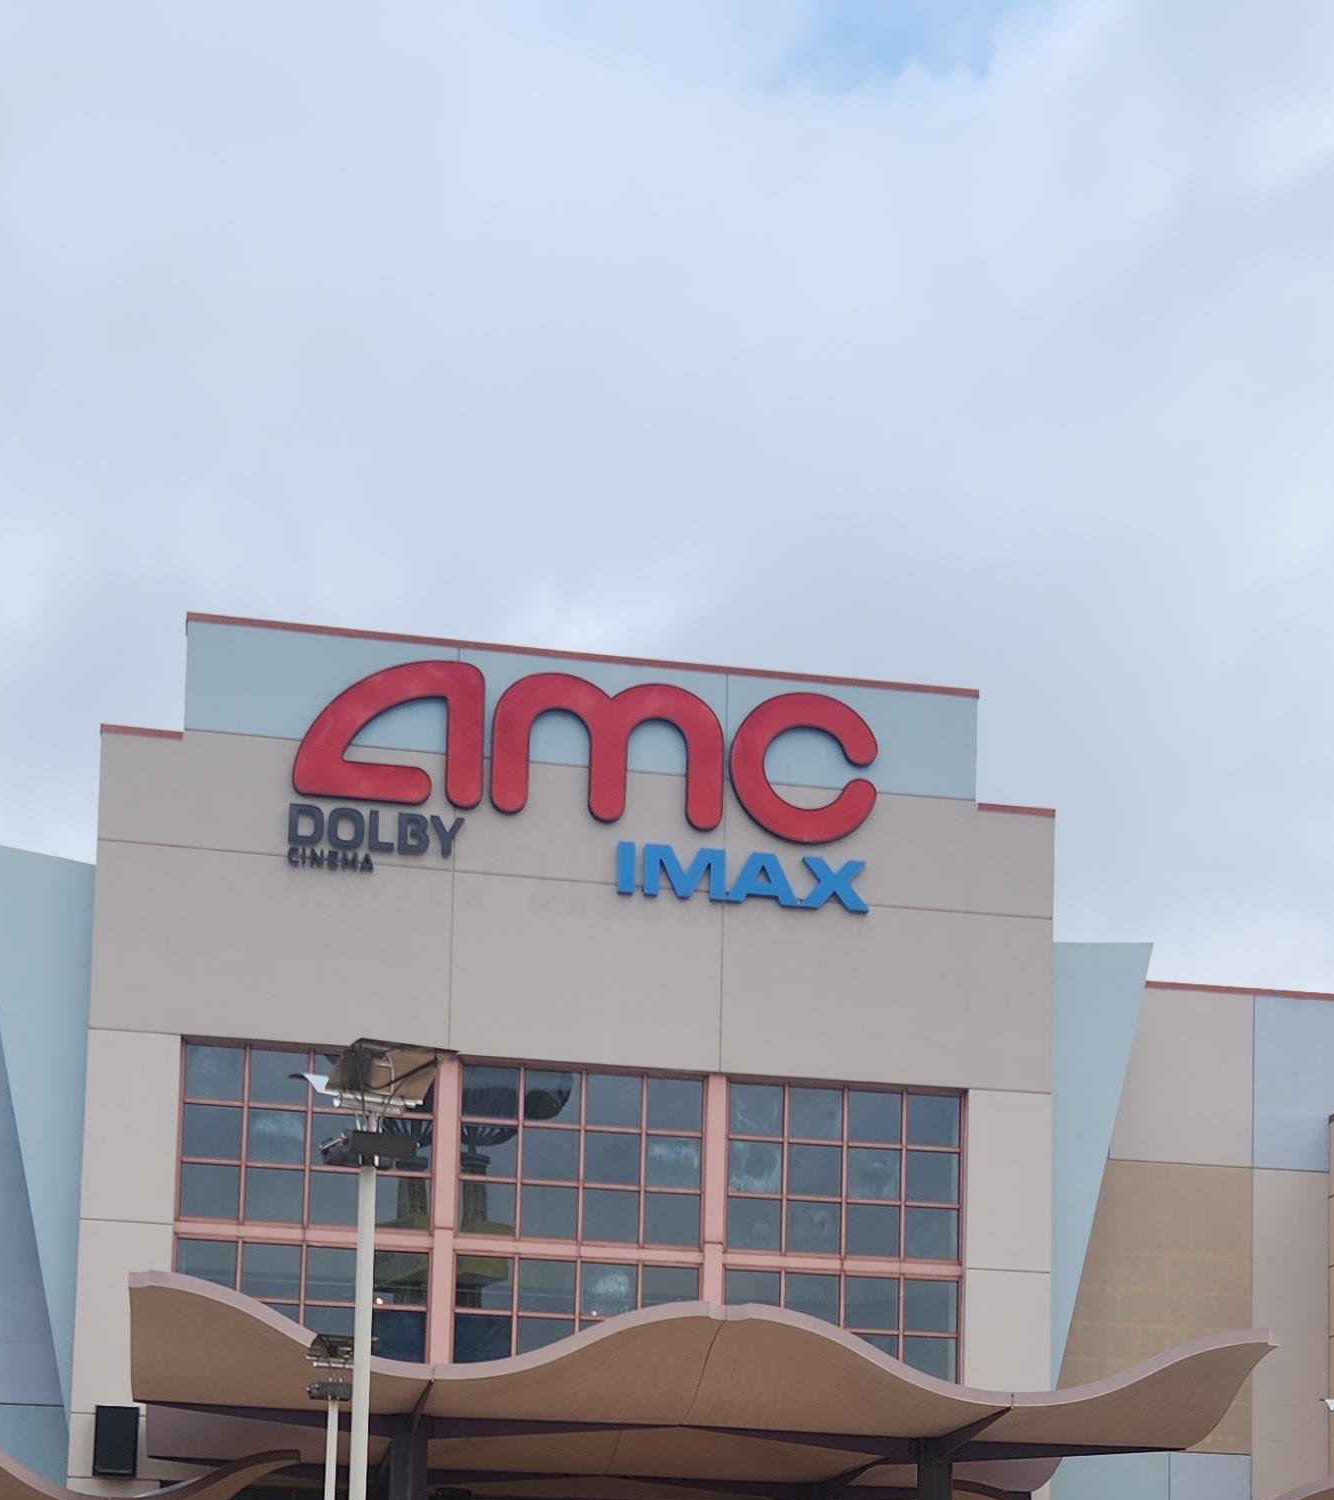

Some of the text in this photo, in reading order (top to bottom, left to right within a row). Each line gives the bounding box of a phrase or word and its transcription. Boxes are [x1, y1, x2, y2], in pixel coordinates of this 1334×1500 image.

[287, 803, 465, 859] DOLBY
[287, 846, 375, 873] CINEMA
[615, 840, 870, 914] IMAX
